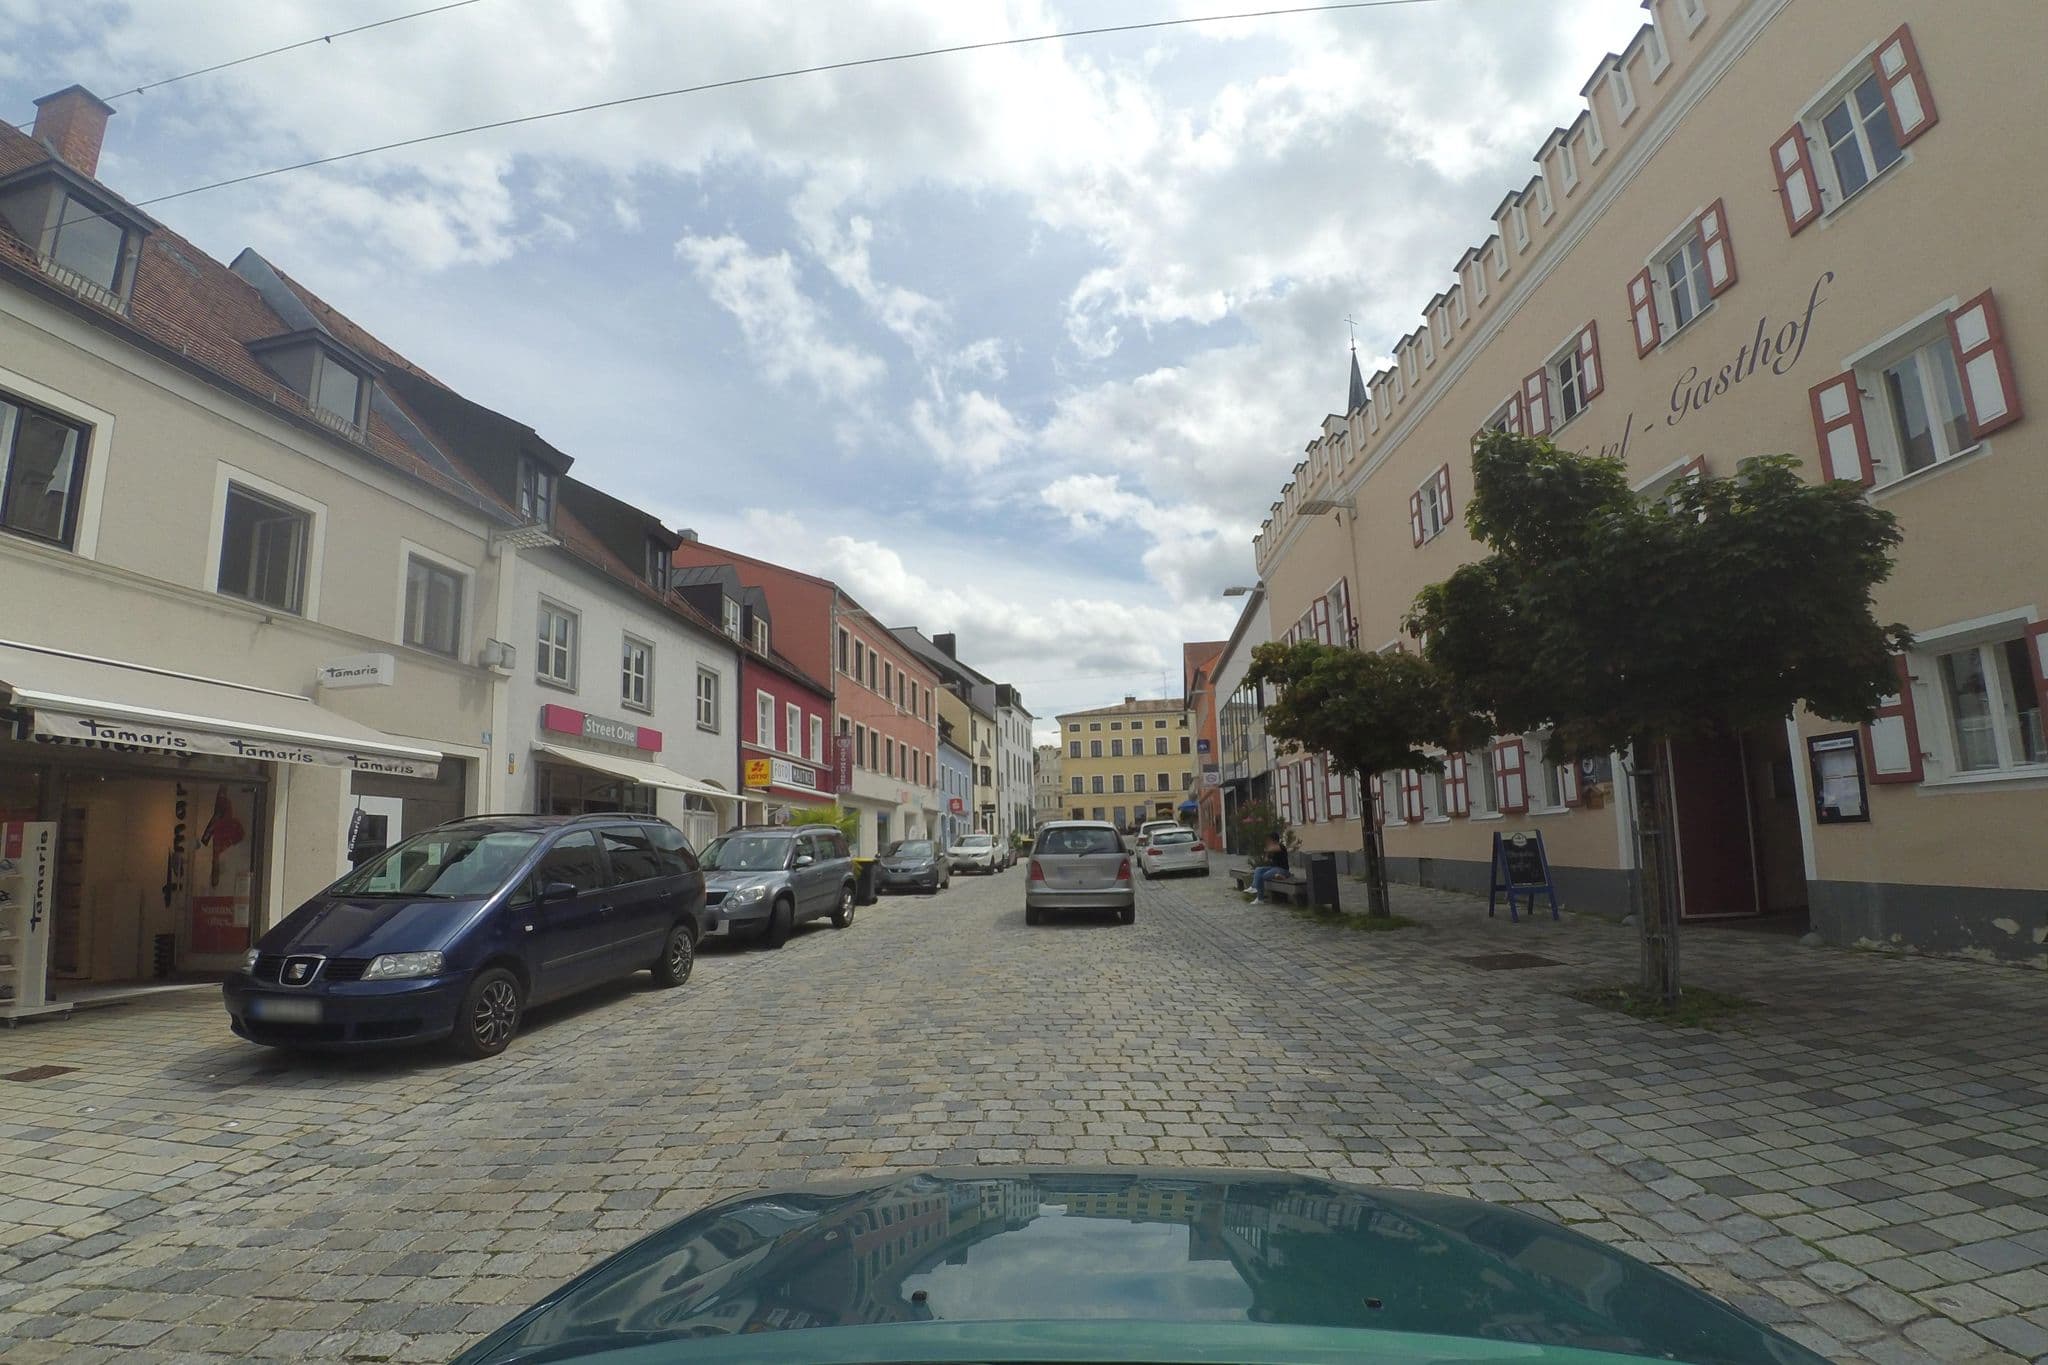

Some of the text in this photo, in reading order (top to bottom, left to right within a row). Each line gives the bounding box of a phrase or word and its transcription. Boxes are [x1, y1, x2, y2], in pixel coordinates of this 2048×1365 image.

[1667, 271, 1834, 426] Gasthof
[326, 664, 378, 678] Tamaris
[78, 719, 188, 748] Tamaris
[585, 719, 635, 742] Street One
[229, 739, 313, 763] Tamaris
[346, 754, 414, 774] Tamaris
[30, 830, 48, 933] Tamaris
